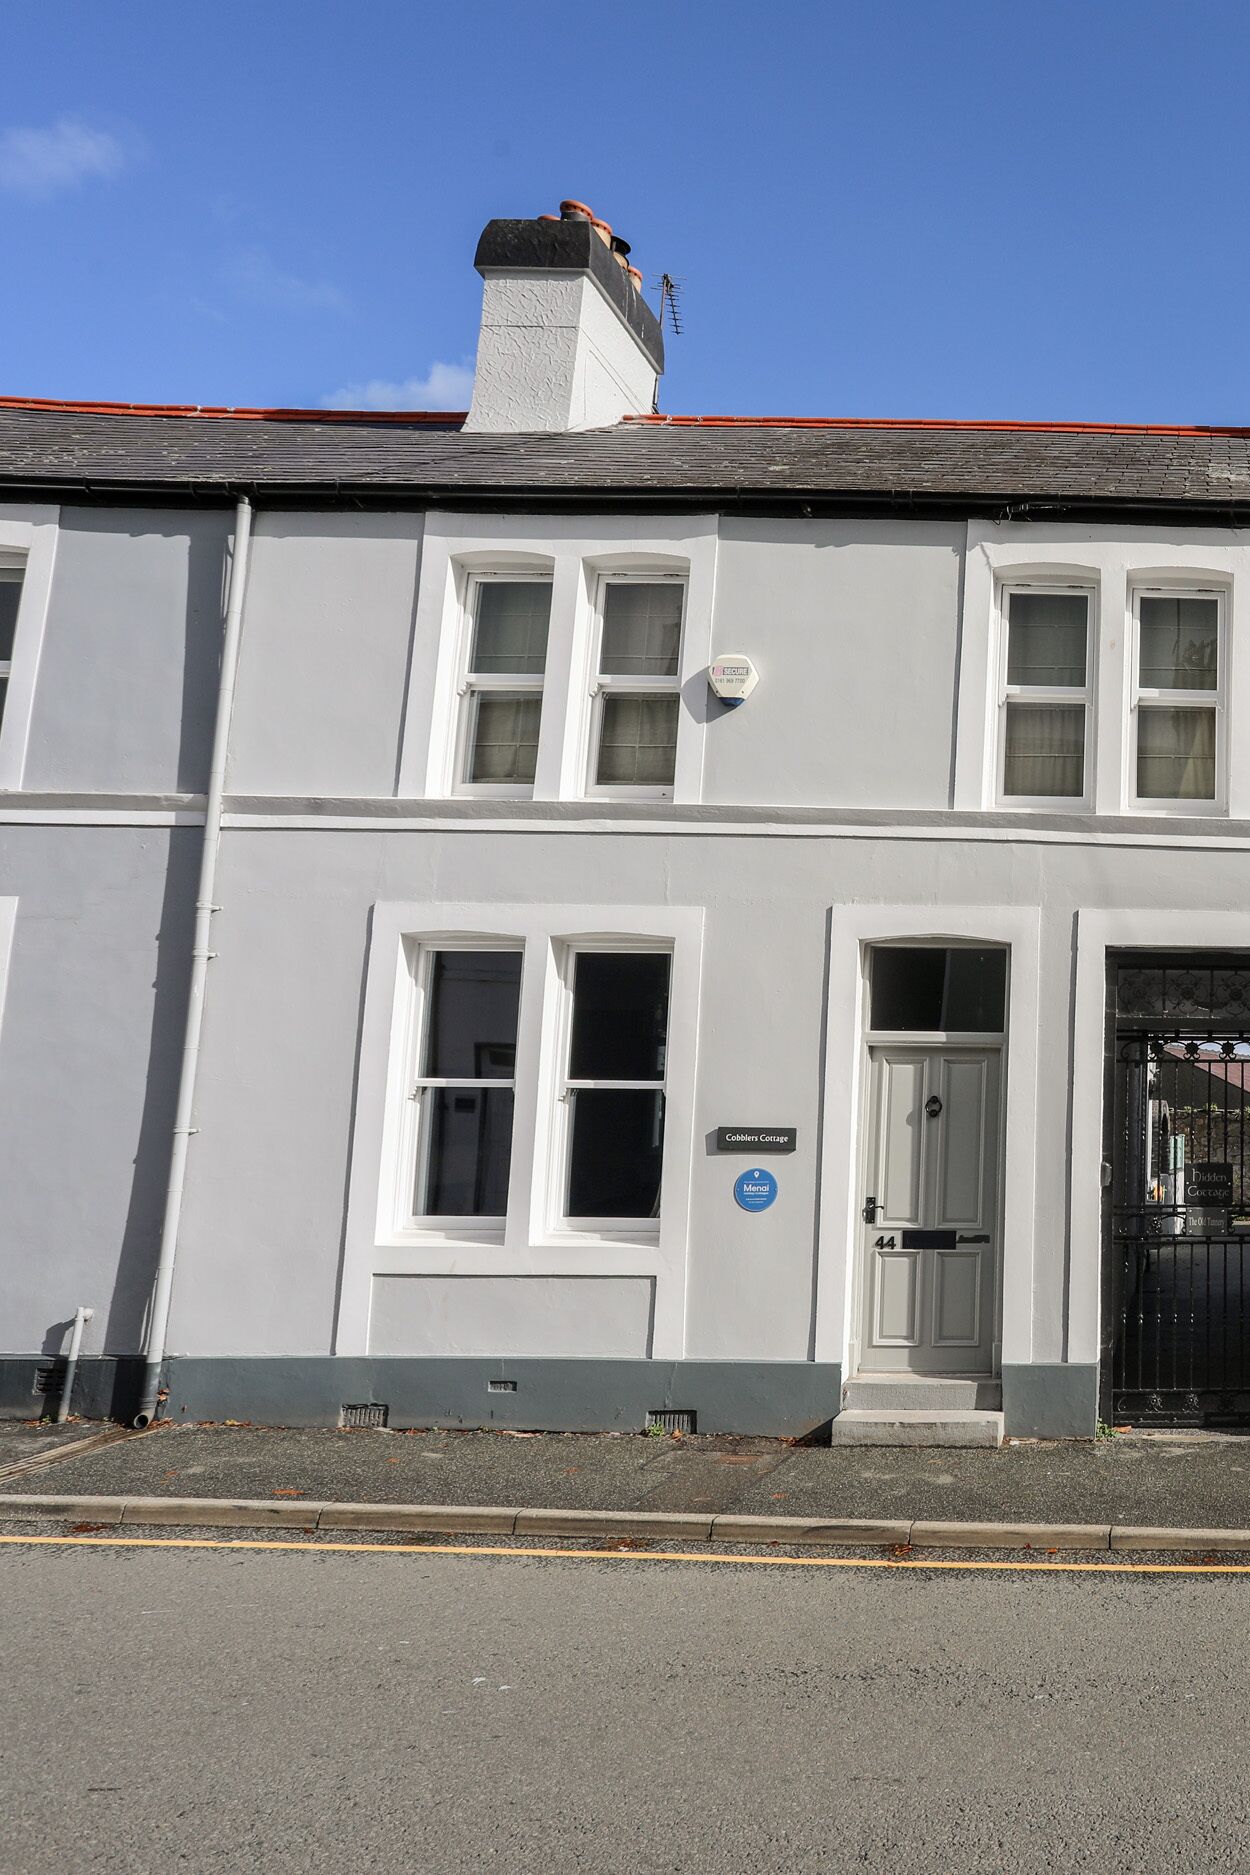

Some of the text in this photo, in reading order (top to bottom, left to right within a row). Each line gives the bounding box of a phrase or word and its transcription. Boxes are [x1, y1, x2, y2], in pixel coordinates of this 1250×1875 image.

[723, 667, 748, 675] SECURE
[725, 1133, 789, 1144] Cobblers Cottage
[743, 1183, 770, 1192] Menai
[1188, 1216, 1197, 1226] The
[874, 1235, 897, 1250] 44
